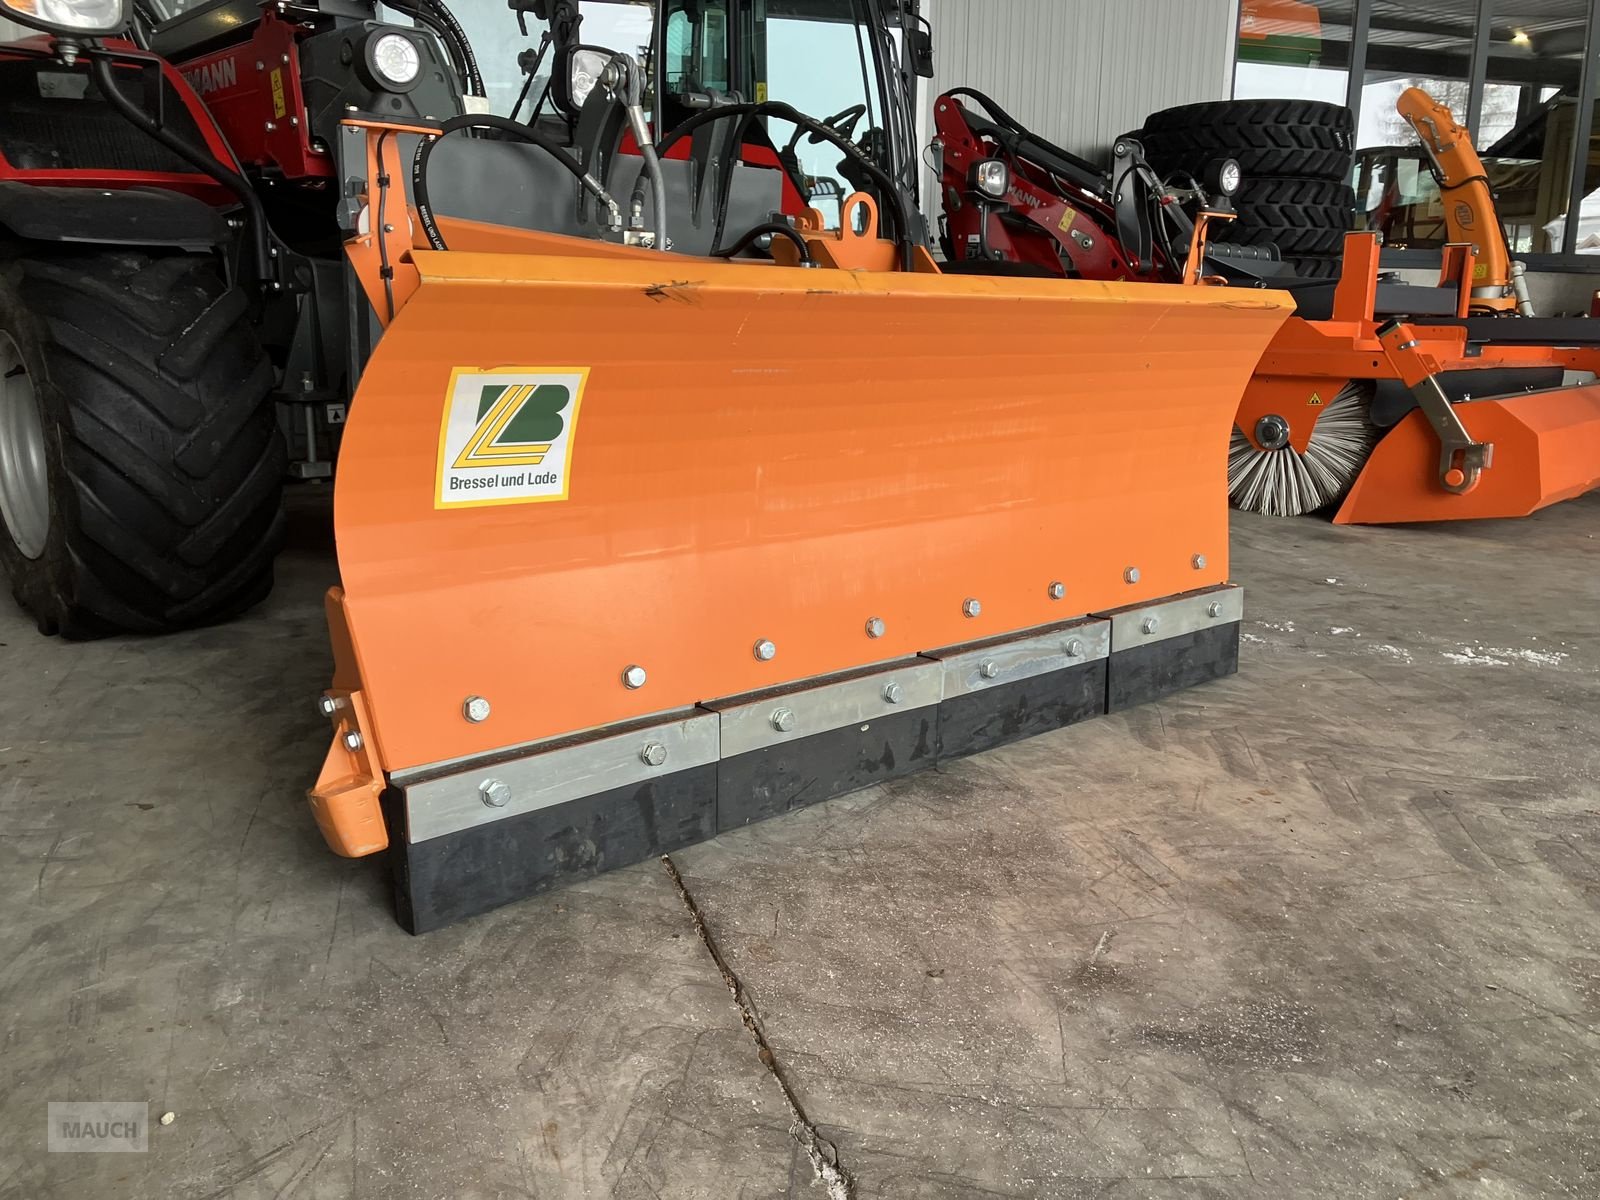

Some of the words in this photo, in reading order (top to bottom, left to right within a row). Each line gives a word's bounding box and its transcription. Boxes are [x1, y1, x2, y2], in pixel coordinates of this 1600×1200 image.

[183, 57, 237, 95] MANN
[419, 205, 431, 228] BRESSEL
[427, 226, 436, 238] UND
[450, 474, 499, 490] Bressel
[501, 473, 525, 487] und
[528, 471, 557, 485] Lade
